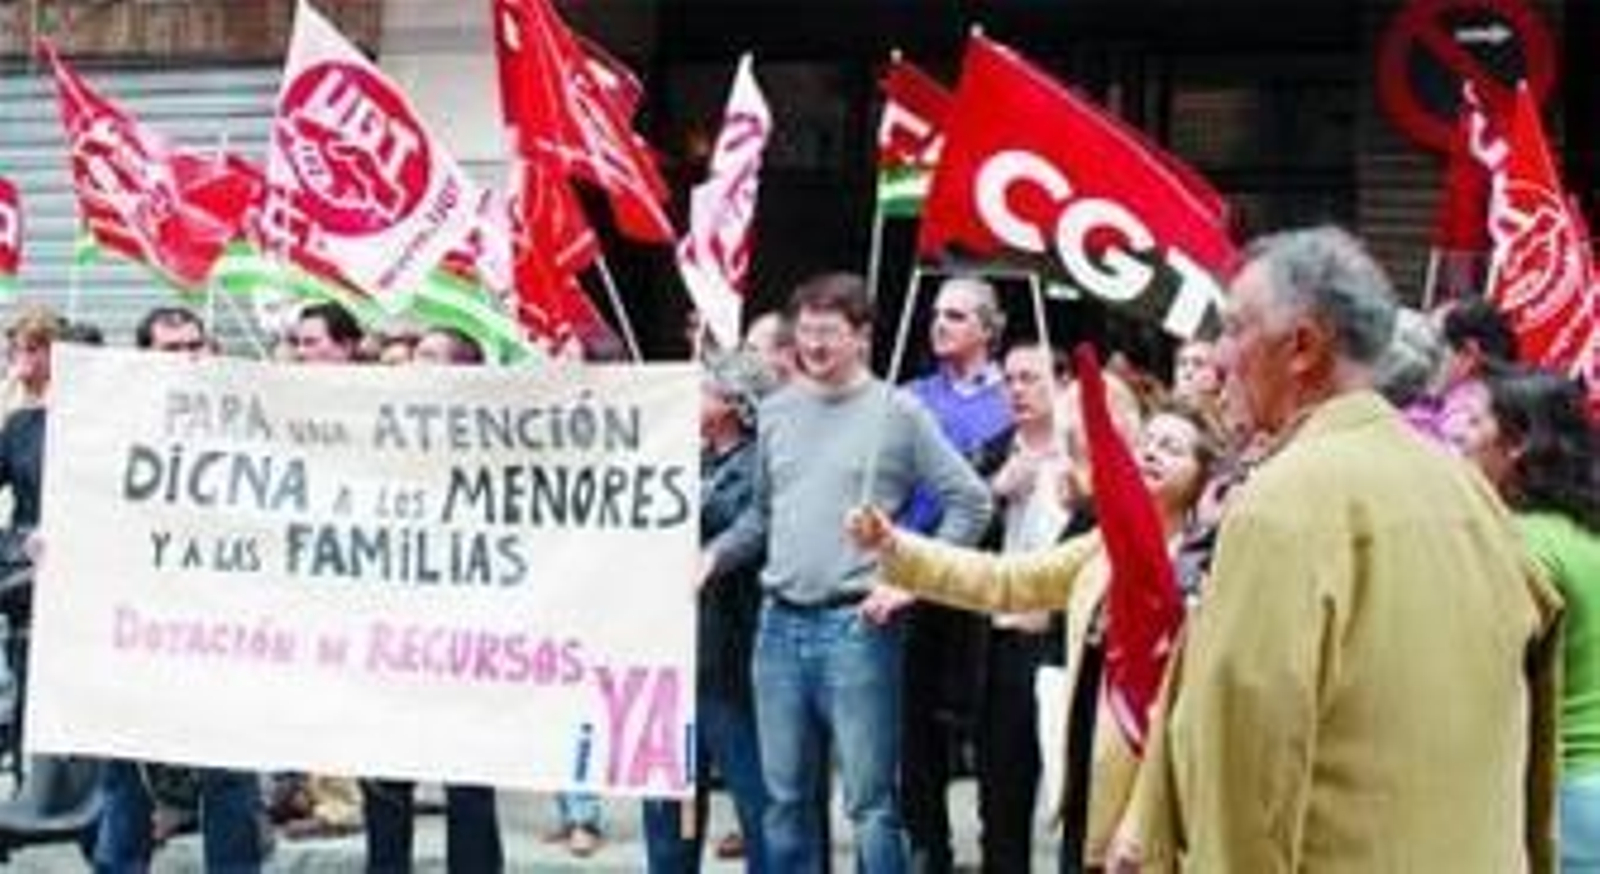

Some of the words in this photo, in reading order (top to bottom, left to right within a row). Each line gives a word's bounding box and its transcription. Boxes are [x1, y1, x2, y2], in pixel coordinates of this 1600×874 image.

[289, 66, 423, 184] UGT
[975, 149, 1224, 340] CGT
[163, 392, 272, 440] PARA
[374, 389, 642, 450] ATENCIÓN
[441, 464, 691, 529] MENORES
[150, 530, 171, 570] Y
[183, 539, 202, 569] A
[285, 523, 528, 587] FAMILIAS
[365, 620, 584, 686] RECURSOS
